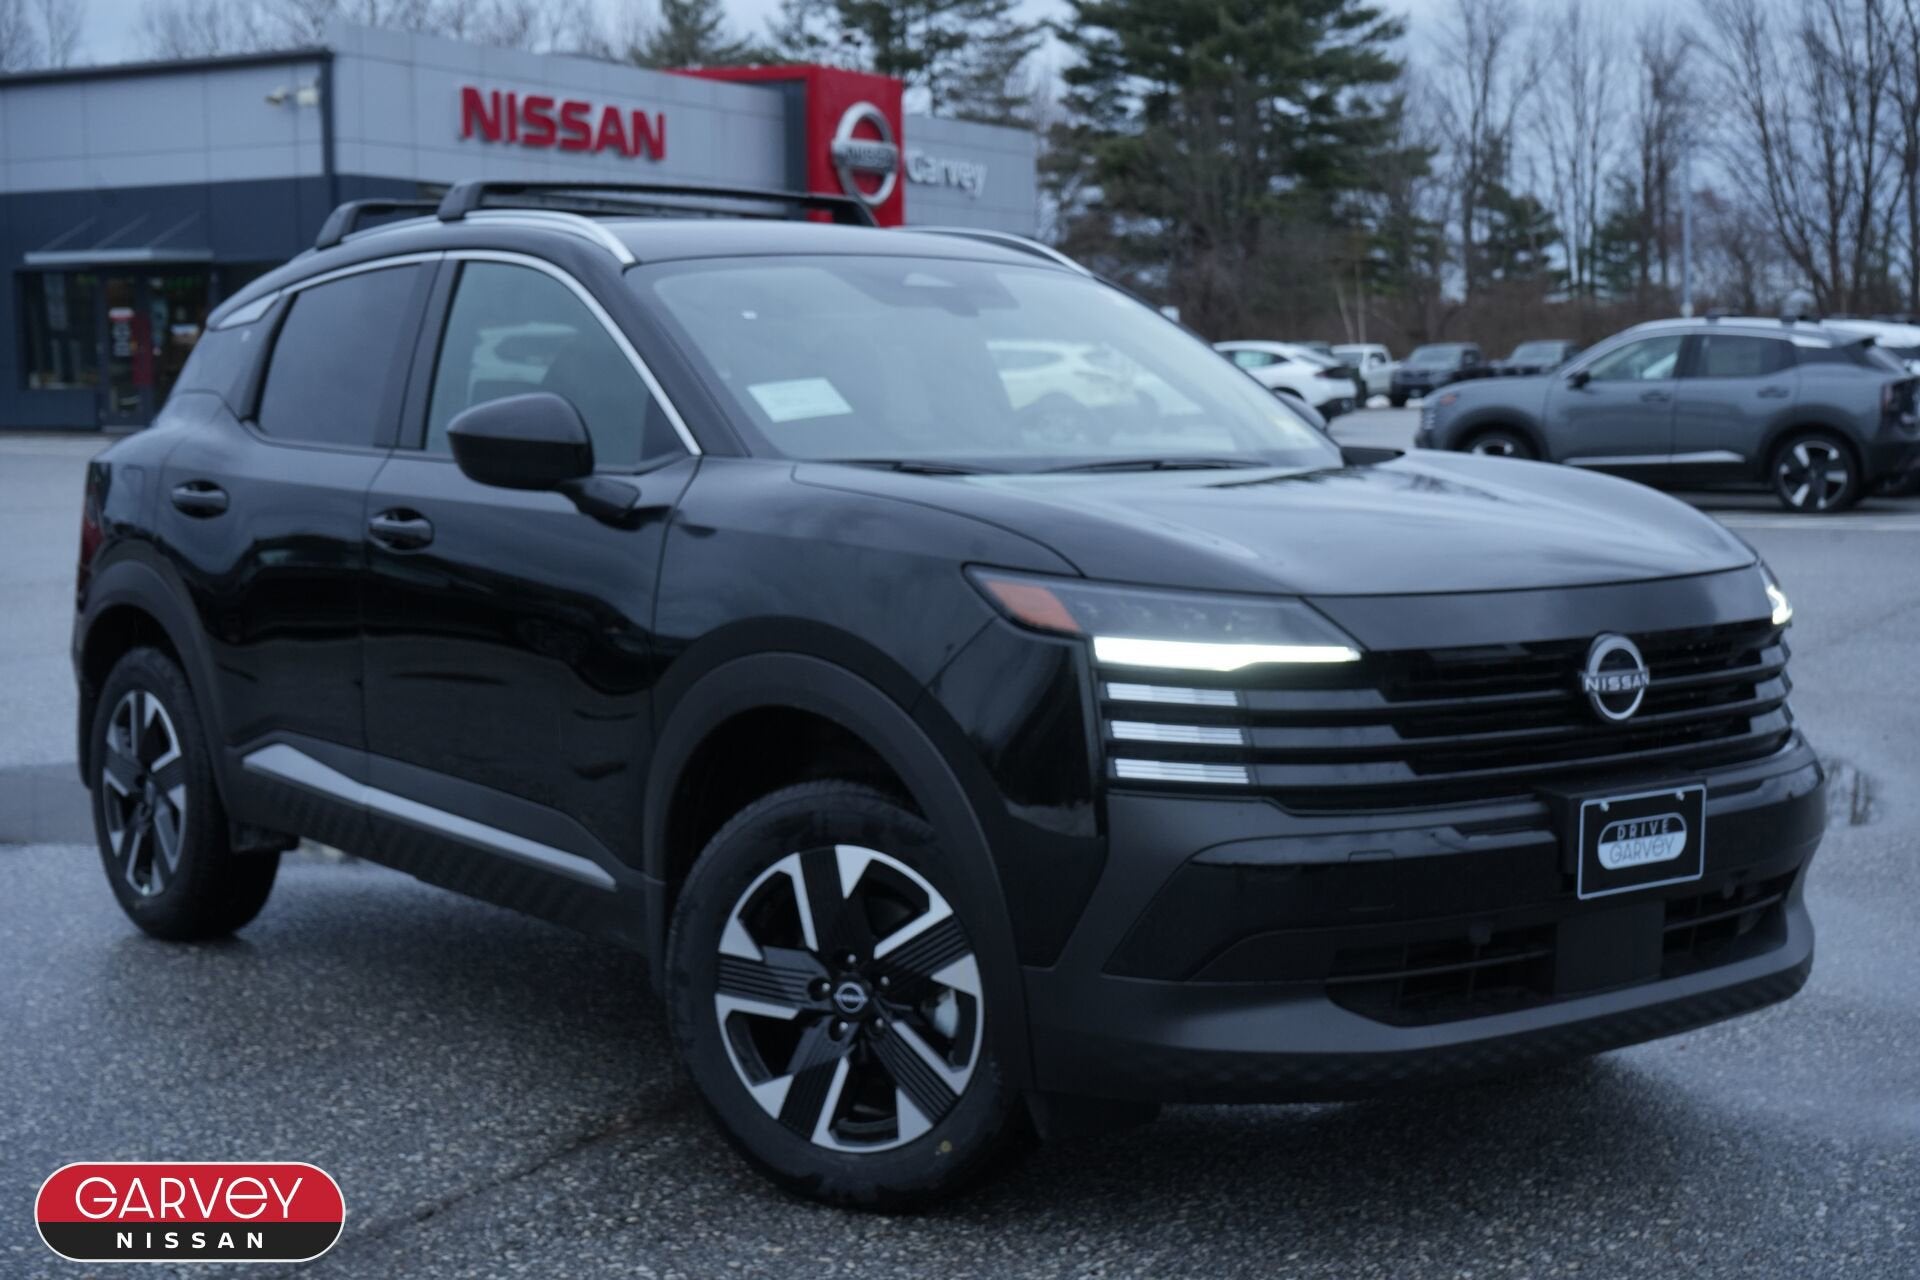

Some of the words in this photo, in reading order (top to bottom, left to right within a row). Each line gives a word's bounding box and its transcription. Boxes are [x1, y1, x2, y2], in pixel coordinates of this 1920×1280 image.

[461, 86, 665, 160] NISSAN
[906, 150, 987, 197] Garvey
[1585, 673, 1649, 692] NISSAN
[1617, 818, 1669, 841] DRIVE
